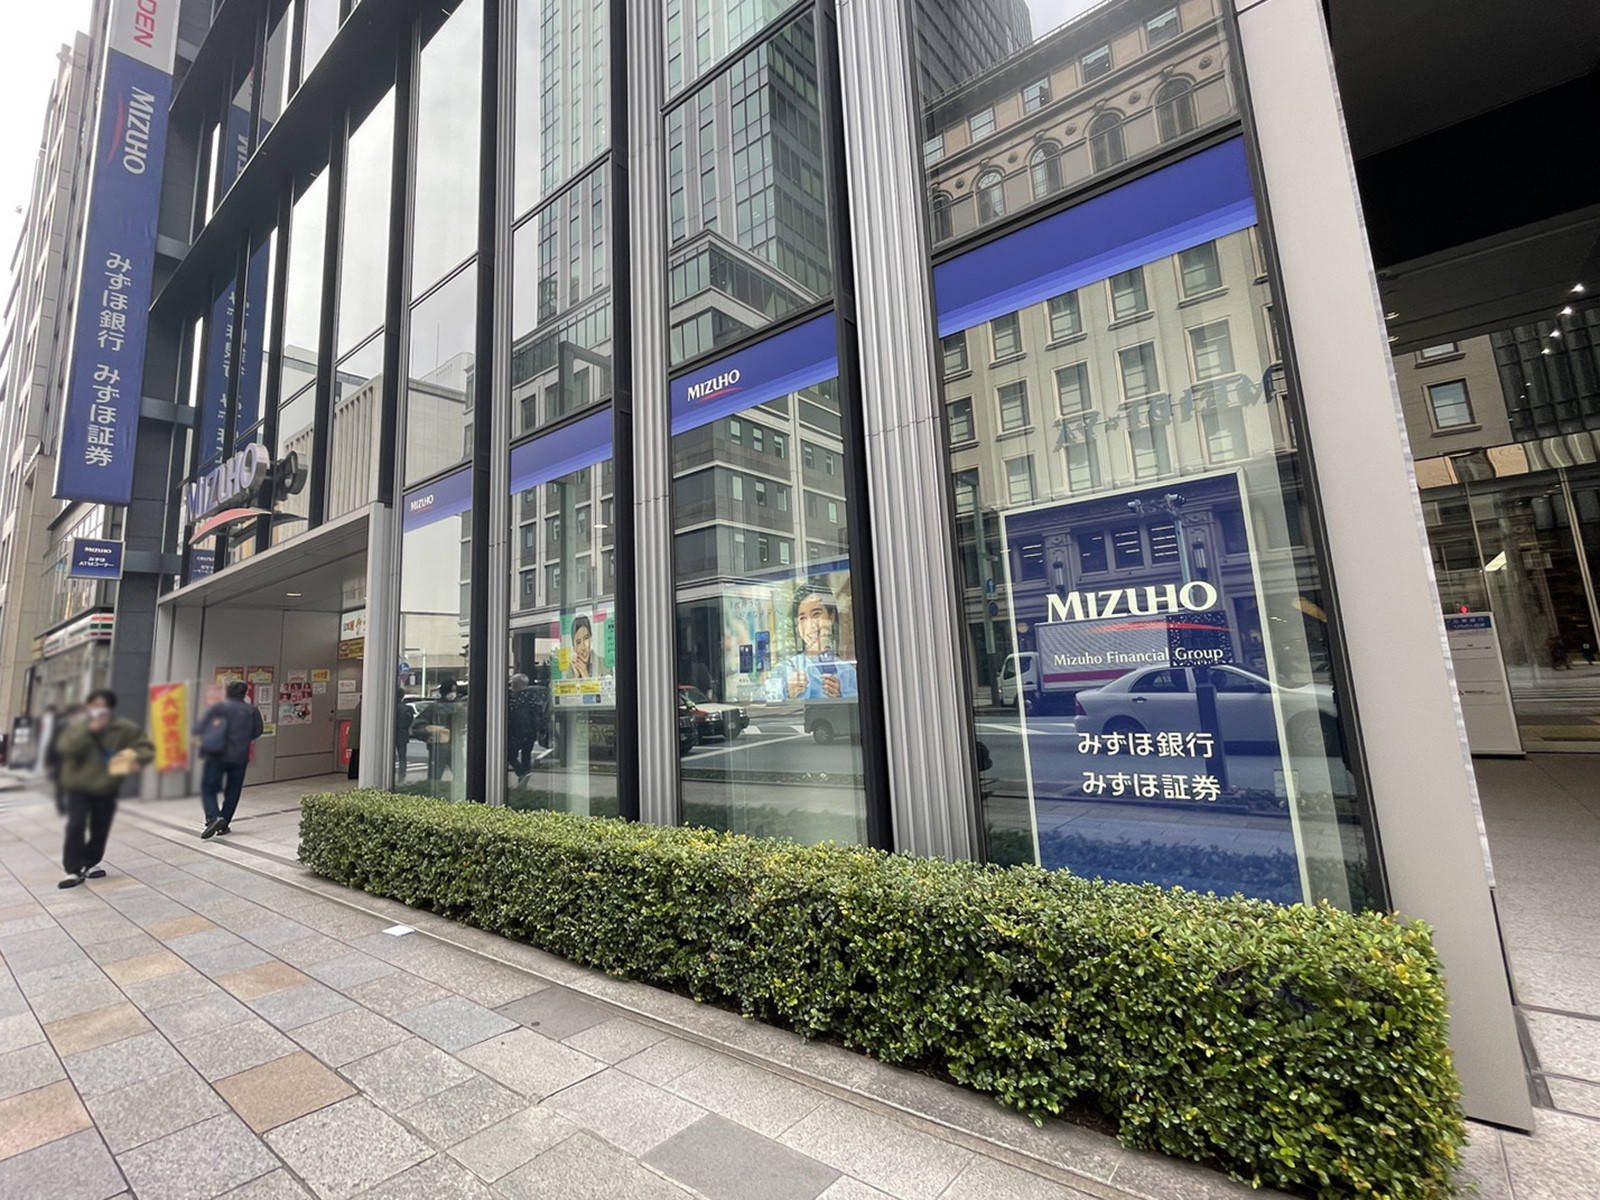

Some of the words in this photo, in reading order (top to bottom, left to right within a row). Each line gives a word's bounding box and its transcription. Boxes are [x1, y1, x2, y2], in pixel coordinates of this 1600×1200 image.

[123, 86, 155, 175] MIZUHO
[97, 252, 132, 352] みずほ銀行
[687, 369, 741, 401] MIZUHO
[85, 364, 120, 467] みずほ証券
[410, 494, 434, 512] MIZUHO
[1046, 581, 1217, 622] MIZUHO
[1053, 652, 1103, 666] Mizuho
[1106, 647, 1170, 664] Financial
[1174, 646, 1224, 661] Group
[1078, 731, 1214, 758] みずほ銀行
[1081, 772, 1221, 802] みずほ証券
